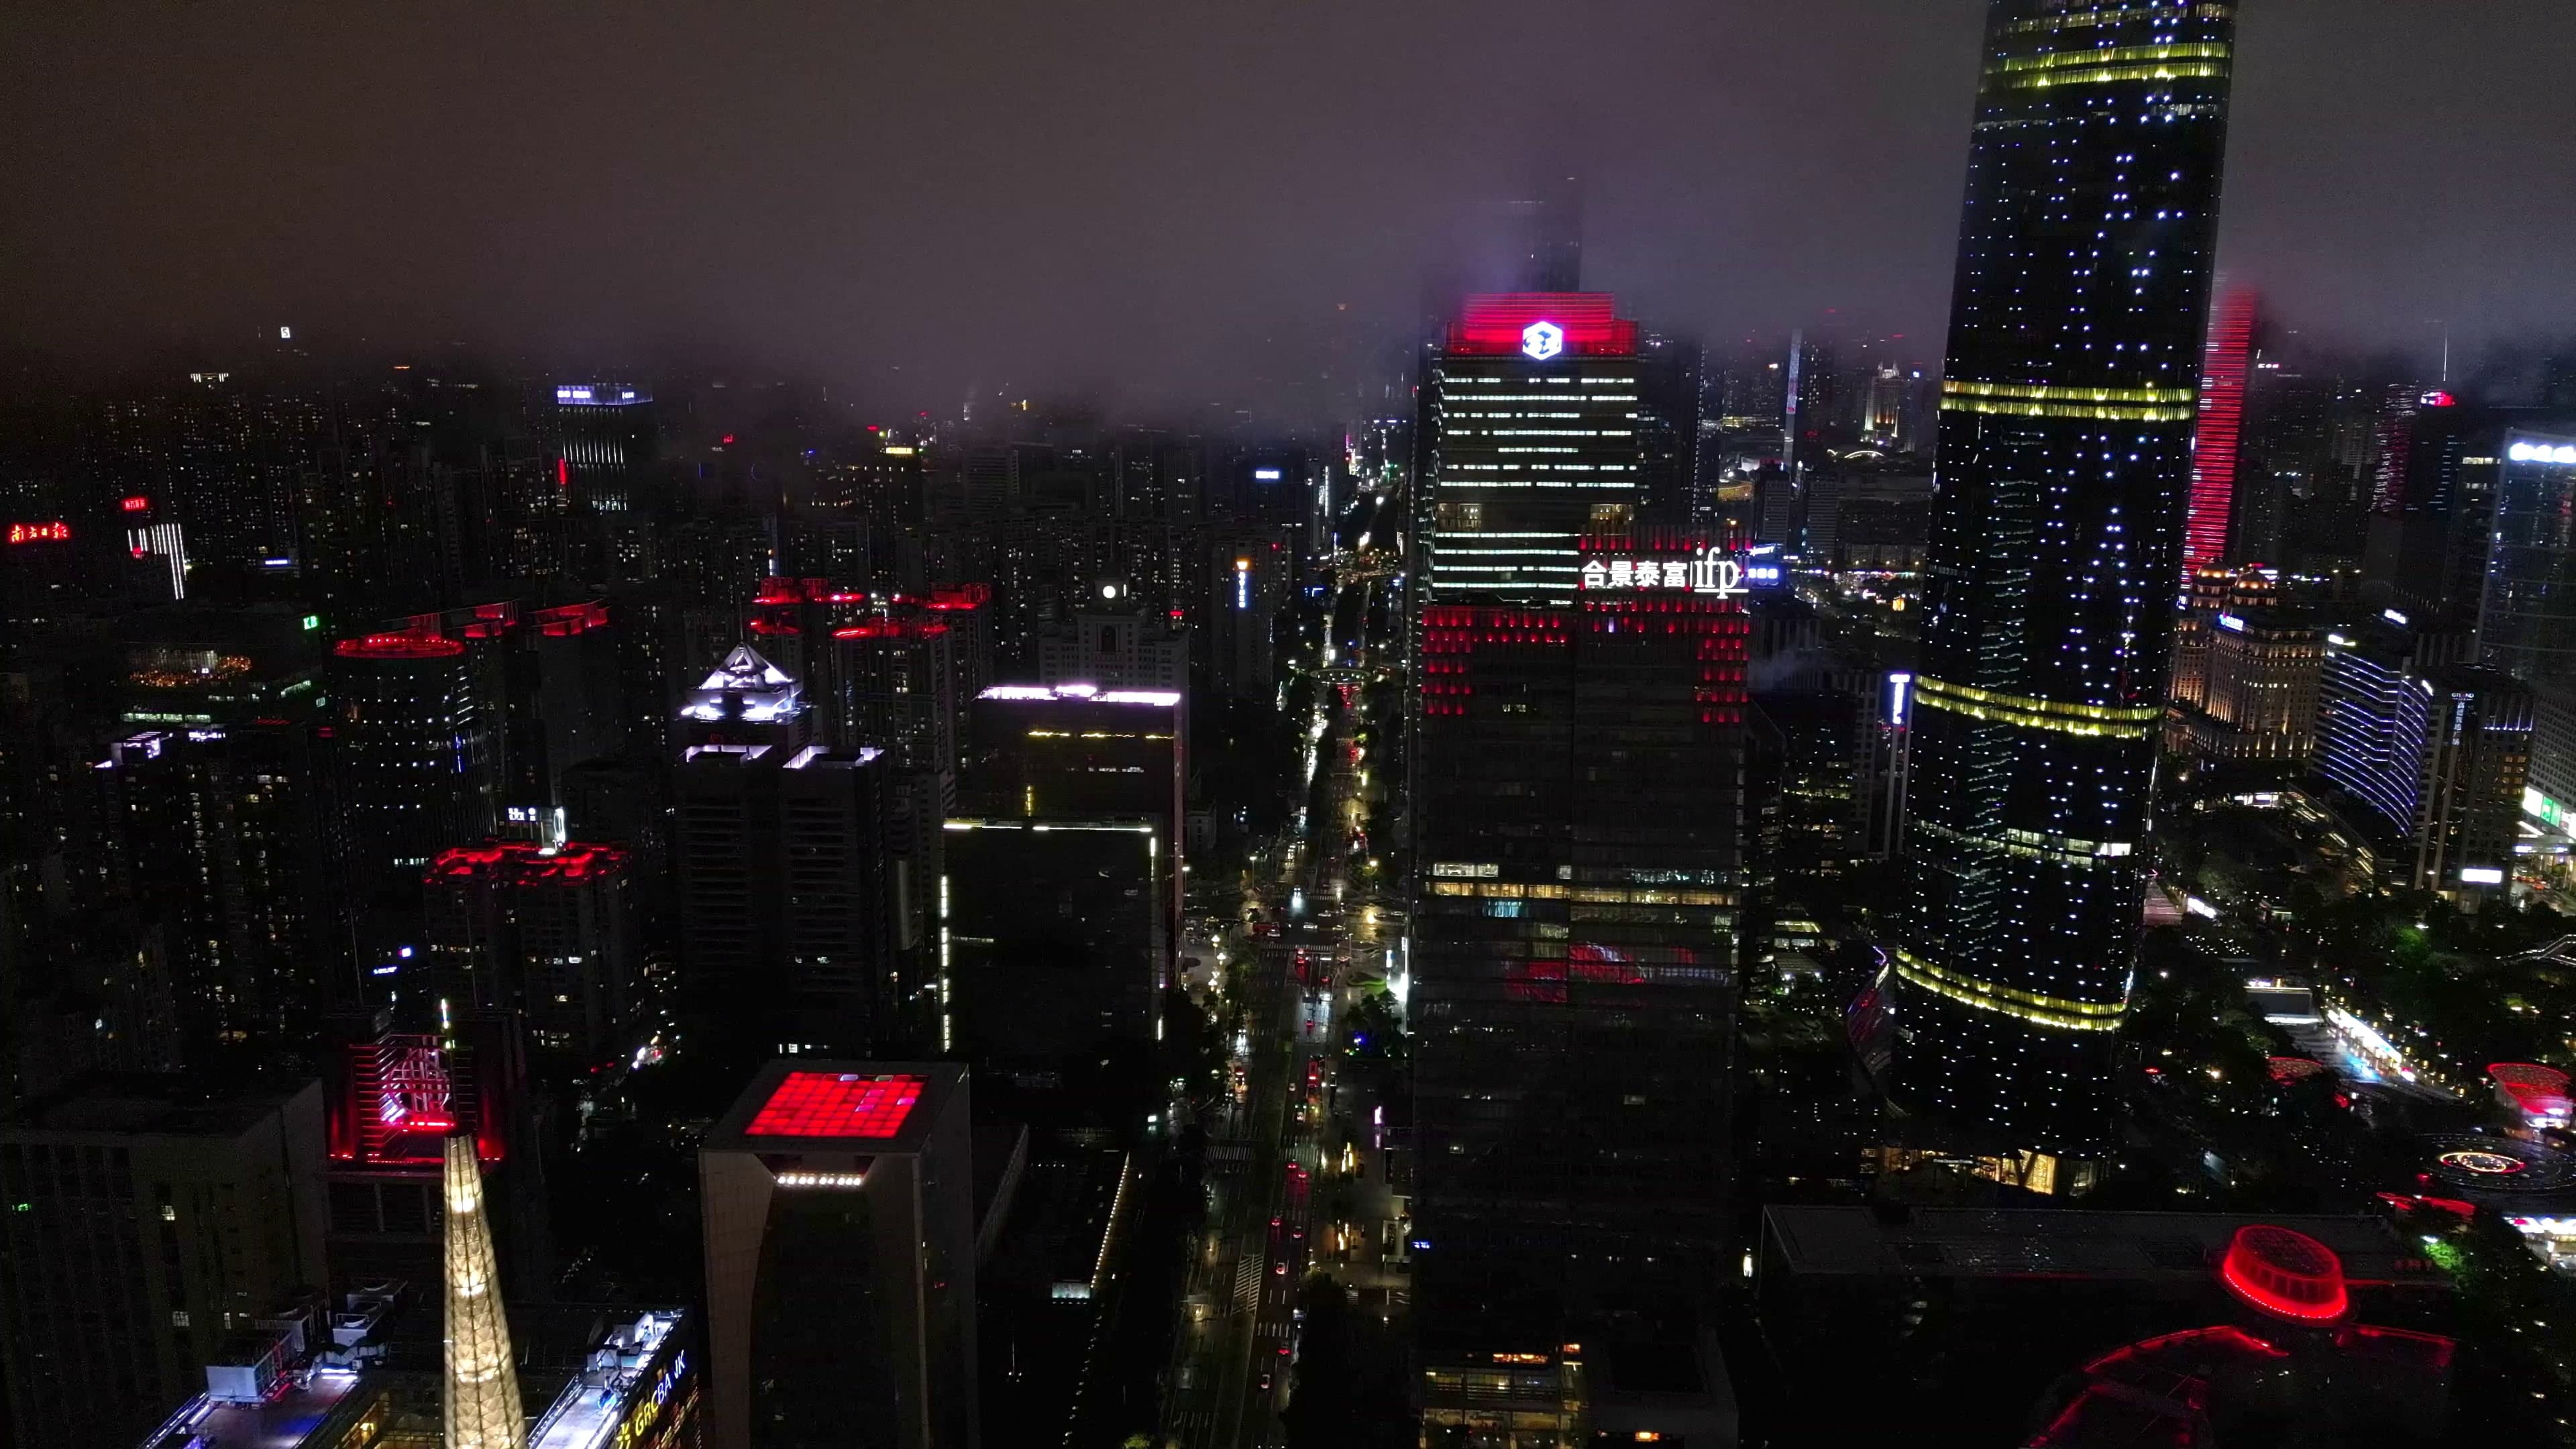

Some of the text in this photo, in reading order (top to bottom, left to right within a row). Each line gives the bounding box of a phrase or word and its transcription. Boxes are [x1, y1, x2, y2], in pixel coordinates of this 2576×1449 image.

[1582, 547, 1740, 599] 合景泰富 ifp
